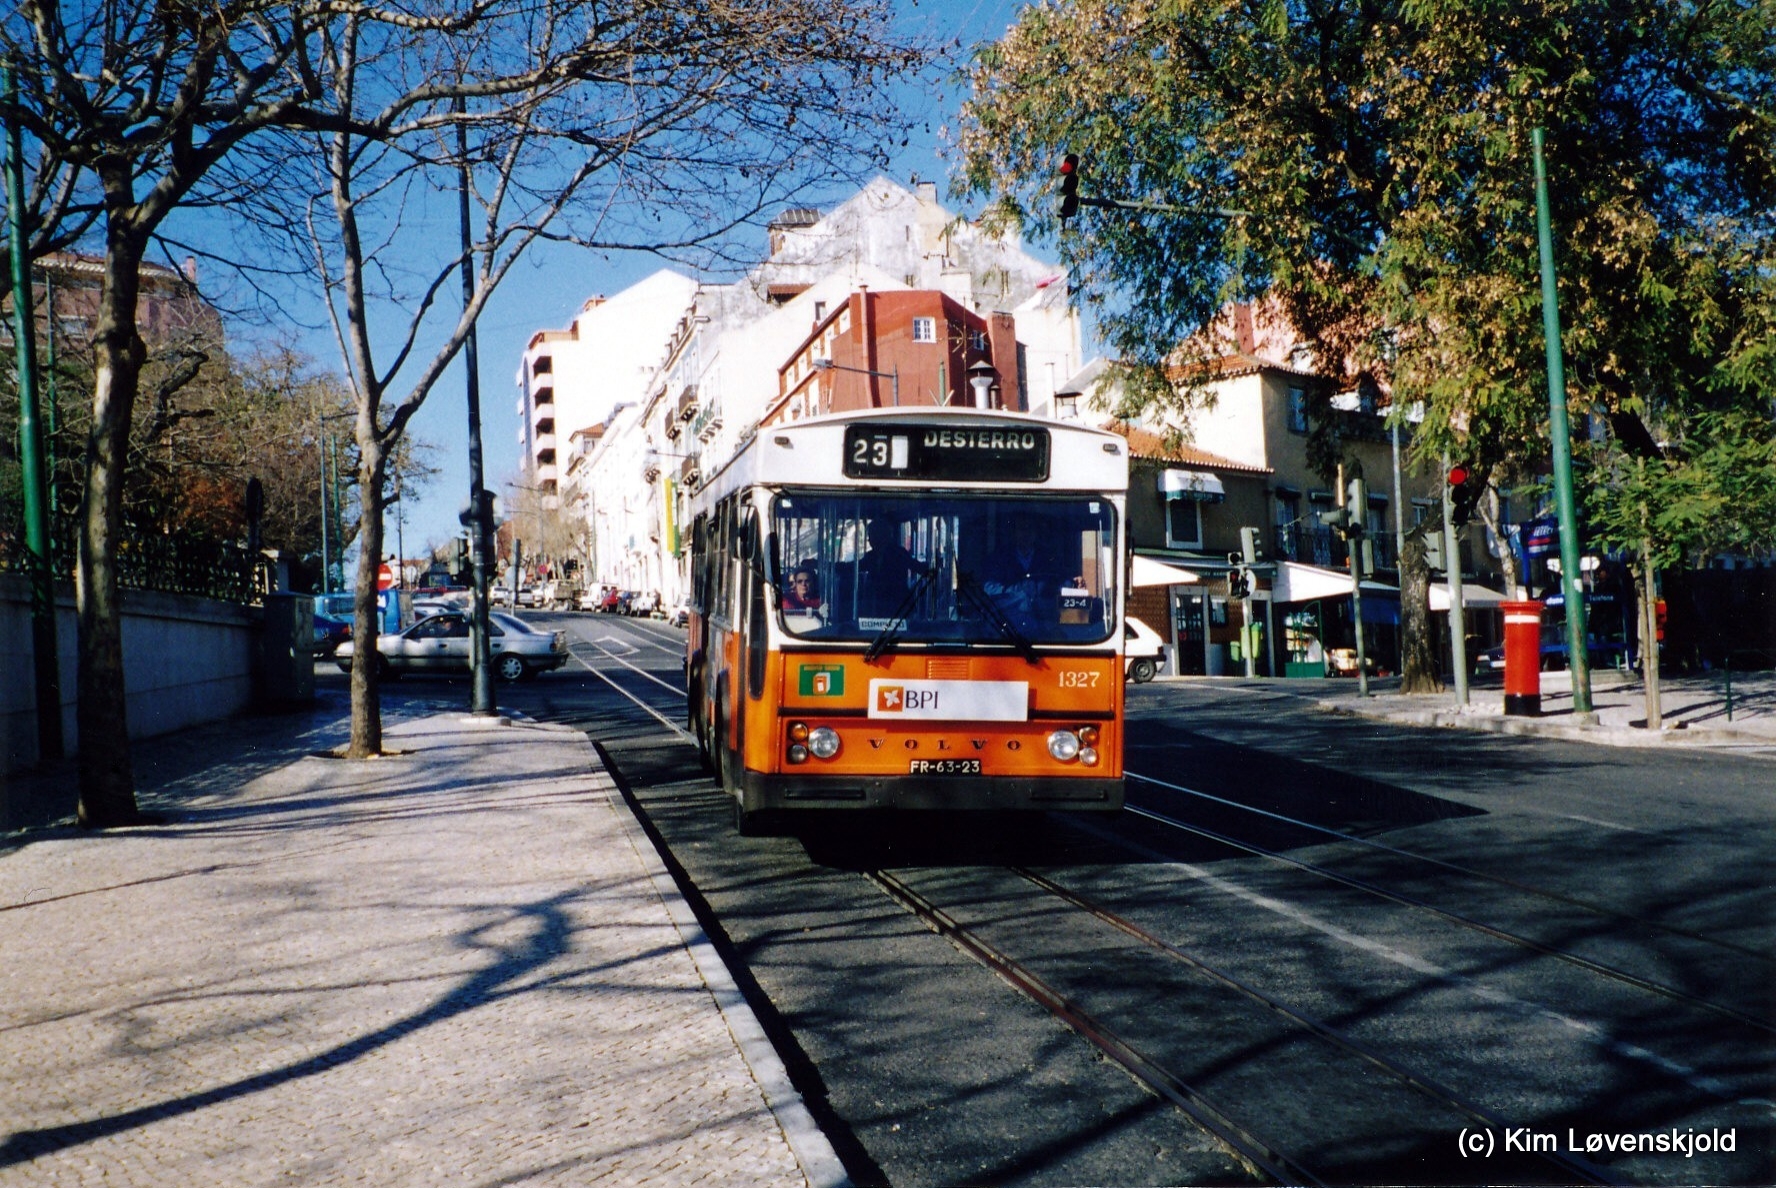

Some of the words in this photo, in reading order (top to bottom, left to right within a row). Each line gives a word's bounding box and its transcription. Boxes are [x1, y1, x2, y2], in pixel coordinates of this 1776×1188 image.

[924, 430, 1035, 449] DESTERRO
[852, 438, 888, 467] 23
[1063, 598, 1087, 608] 23-4
[1058, 671, 1101, 688] 1327
[904, 689, 939, 710] BPI
[868, 738, 1022, 751] VOLVO
[909, 759, 981, 774] FR-63-23
